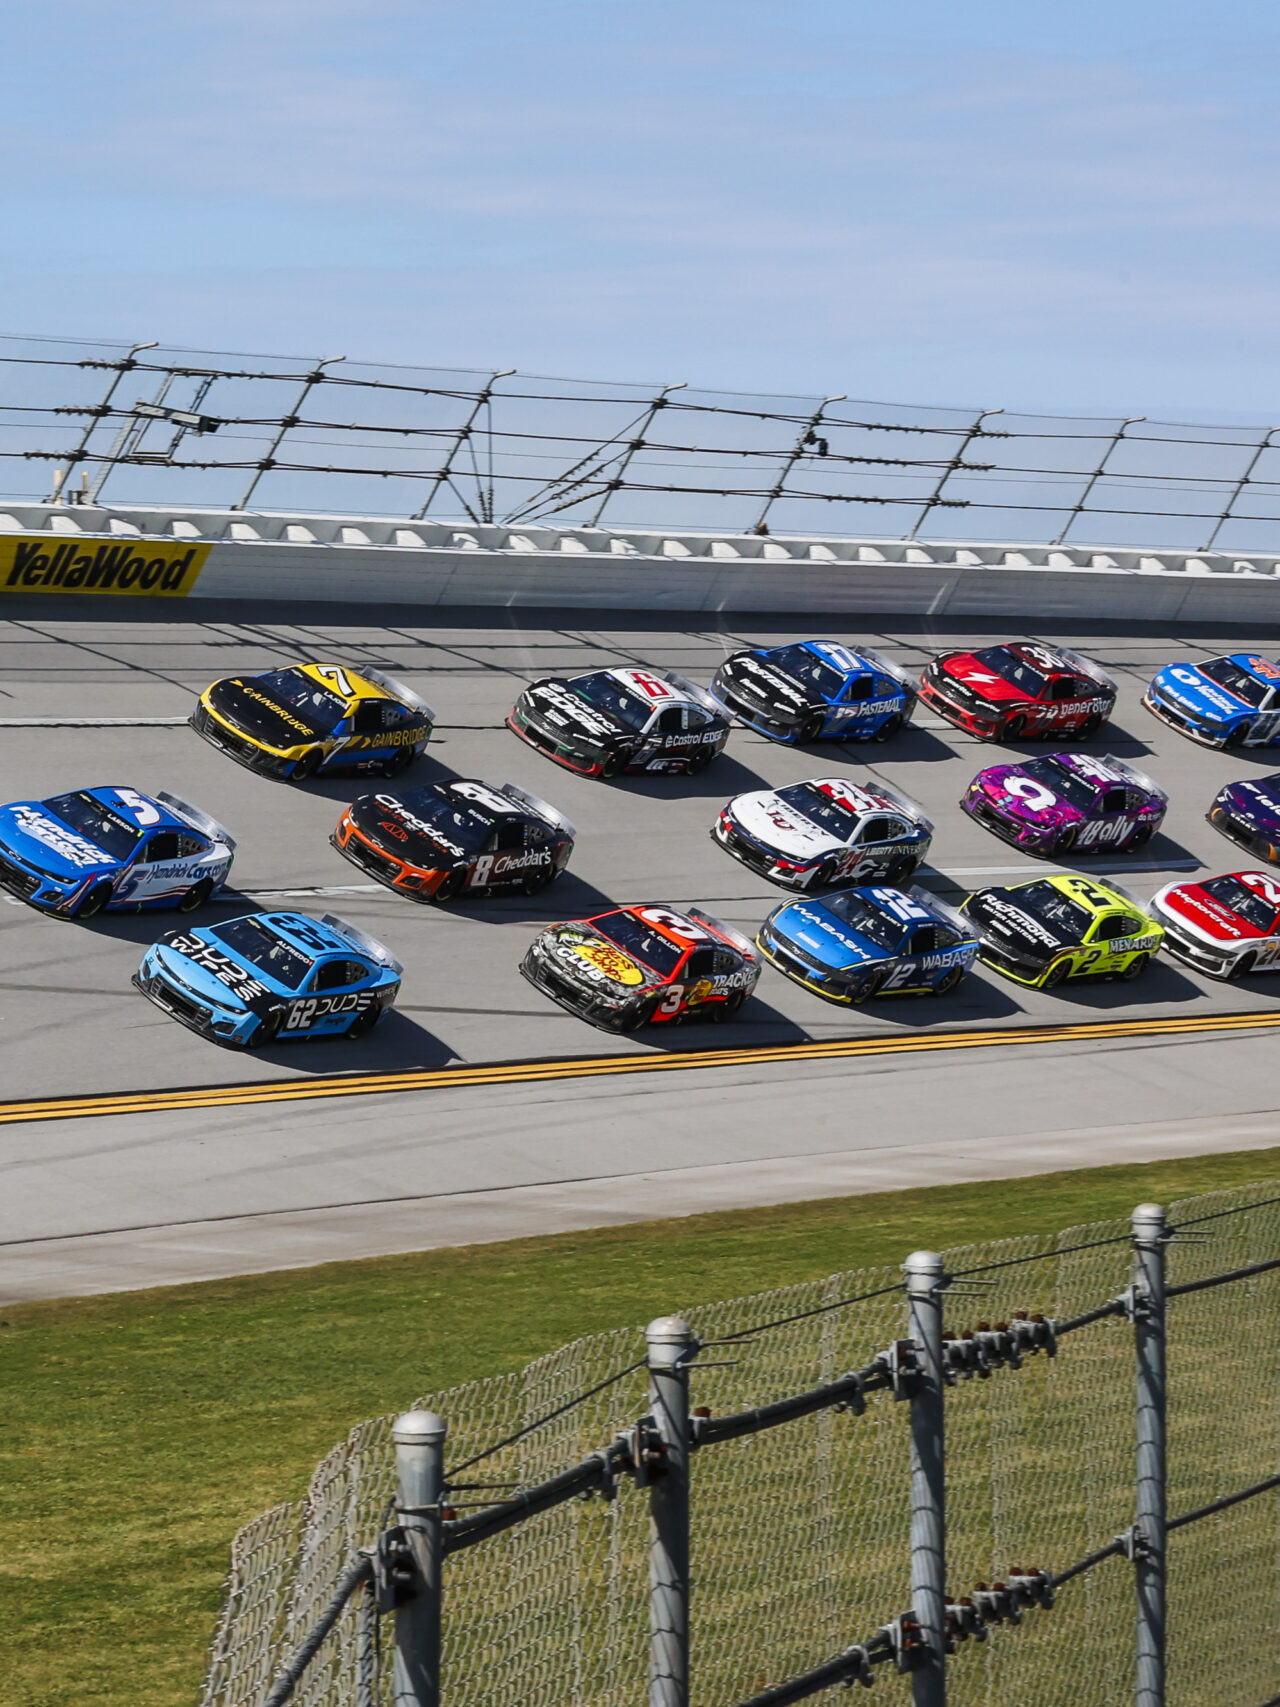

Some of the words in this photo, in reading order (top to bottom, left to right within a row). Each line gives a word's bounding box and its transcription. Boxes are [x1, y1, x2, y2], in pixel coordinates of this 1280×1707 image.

[6, 542, 198, 591] YellaWood
[816, 642, 864, 671] 17
[1021, 647, 1065, 669] 38
[317, 666, 356, 698] 7
[629, 671, 671, 699] 6
[733, 657, 808, 707] FASTENAL
[242, 686, 315, 737] GAINBRIDGE
[530, 686, 612, 737] EDGE
[563, 693, 624, 733] Castrol
[858, 699, 902, 718] FASTENAL
[1060, 697, 1113, 719] gener8tor
[322, 736, 351, 765] 7
[371, 724, 428, 748] GAINBRIDGE
[673, 733, 702, 747] Castrol
[114, 789, 163, 826] 5
[451, 783, 521, 813] 8
[107, 813, 134, 834] LARSON
[374, 793, 465, 858] Cheddar's
[466, 808, 492, 826] BUSCH
[1099, 815, 1135, 846] ally
[1076, 820, 1105, 846] 48
[470, 854, 495, 887] 8
[494, 845, 552, 874] Cheddar's
[111, 869, 151, 900] 5
[1068, 879, 1113, 908] 2
[872, 887, 930, 921] 12
[1172, 888, 1242, 938] Motorcraft
[268, 914, 342, 951] 62
[641, 908, 711, 939] 3
[792, 903, 872, 960] WABASH
[980, 893, 1062, 949] Richmond
[981, 903, 1008, 921] WATER
[1005, 919, 1038, 944] HEATERS
[275, 939, 310, 965] ALFREDO
[656, 935, 681, 953] DILLON
[170, 938, 252, 1002] WIPES
[177, 932, 272, 998] DUDE
[556, 946, 607, 981] CLUB
[881, 963, 917, 989] 12
[1073, 948, 1103, 975] 2
[713, 969, 755, 988] TRACKE
[286, 998, 318, 1030] 62
[315, 992, 375, 1016] DUDE
[660, 984, 685, 1013] 3
